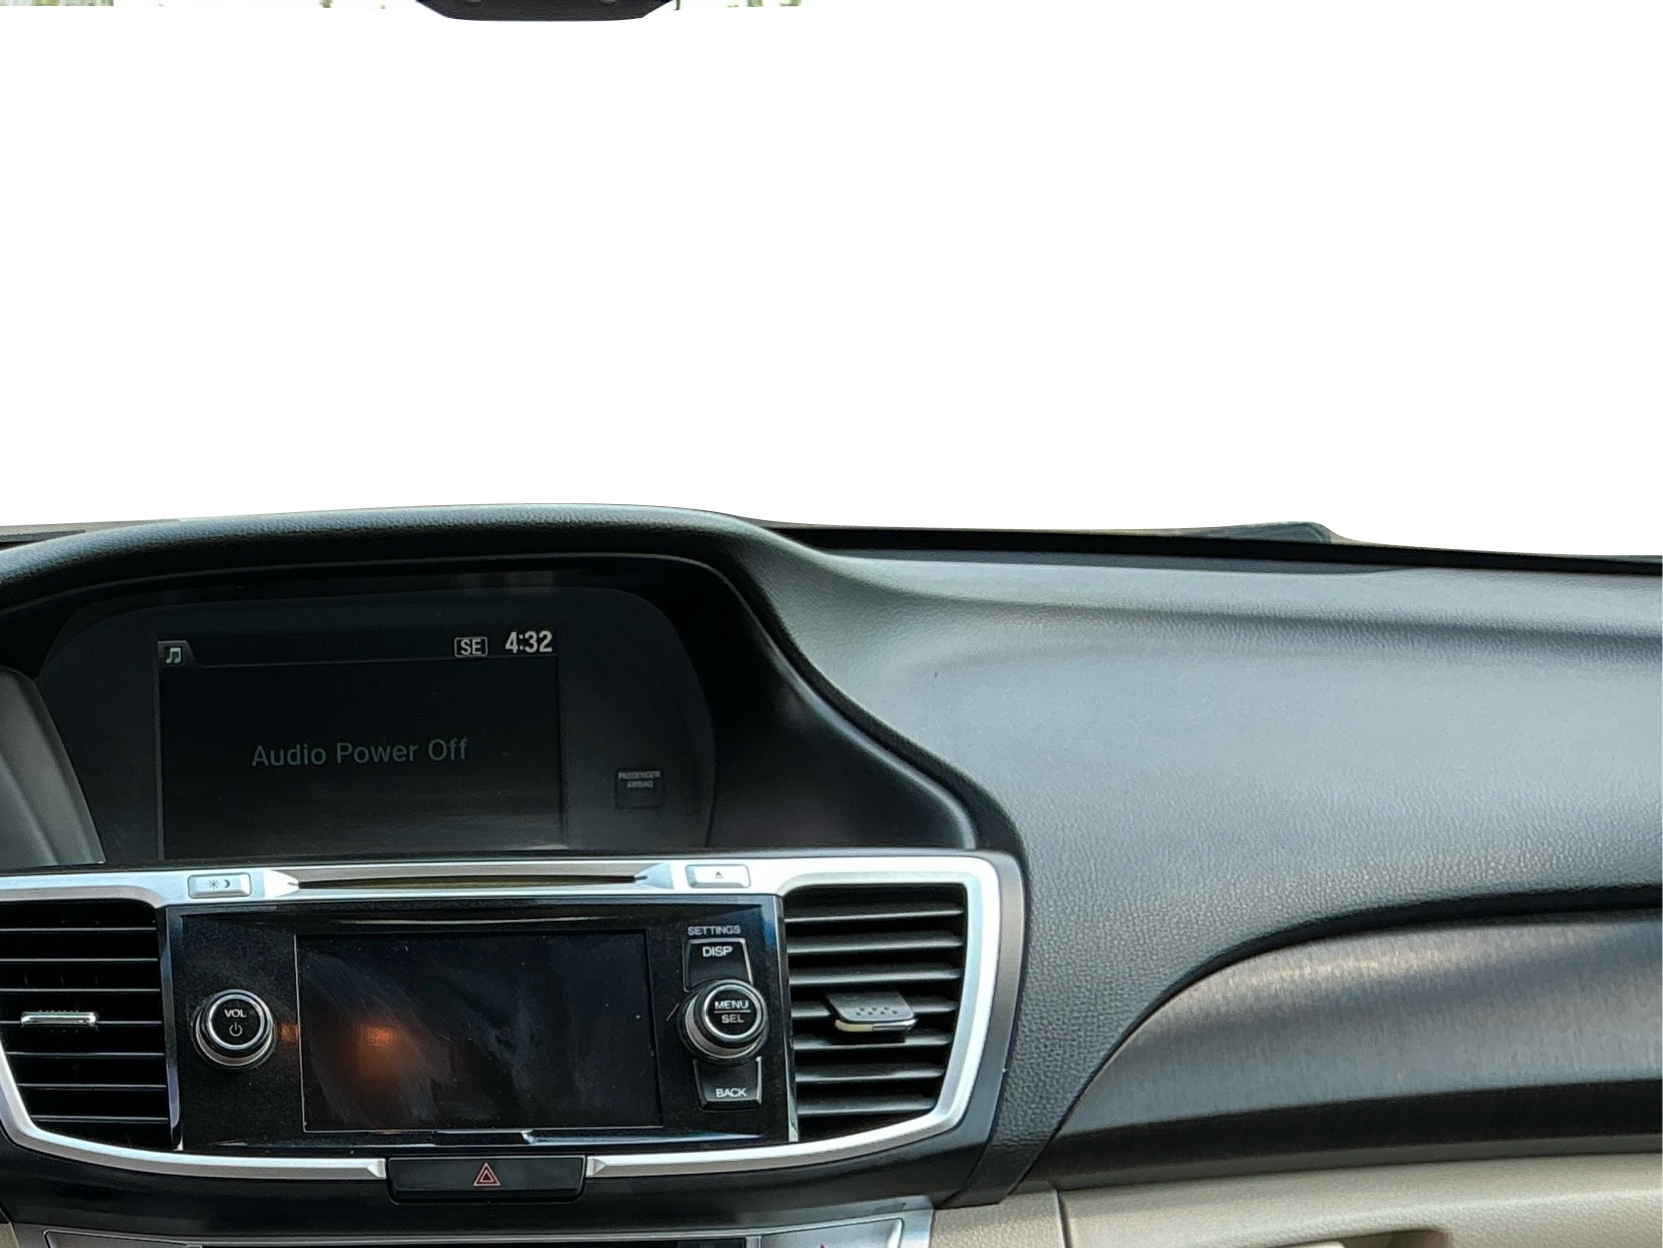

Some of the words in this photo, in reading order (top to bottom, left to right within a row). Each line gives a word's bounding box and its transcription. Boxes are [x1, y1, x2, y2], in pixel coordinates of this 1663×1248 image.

[460, 639, 483, 656] SE
[505, 630, 554, 654] 4:32
[252, 744, 327, 767] Audio
[337, 741, 419, 765] Power
[428, 738, 469, 761] Off
[687, 925, 741, 935] SETTINGS
[702, 946, 733, 957] DISP
[714, 1000, 750, 1010] MENU
[224, 1009, 247, 1018] VOL
[721, 1014, 745, 1023] SEL
[715, 1087, 748, 1098] BACK
